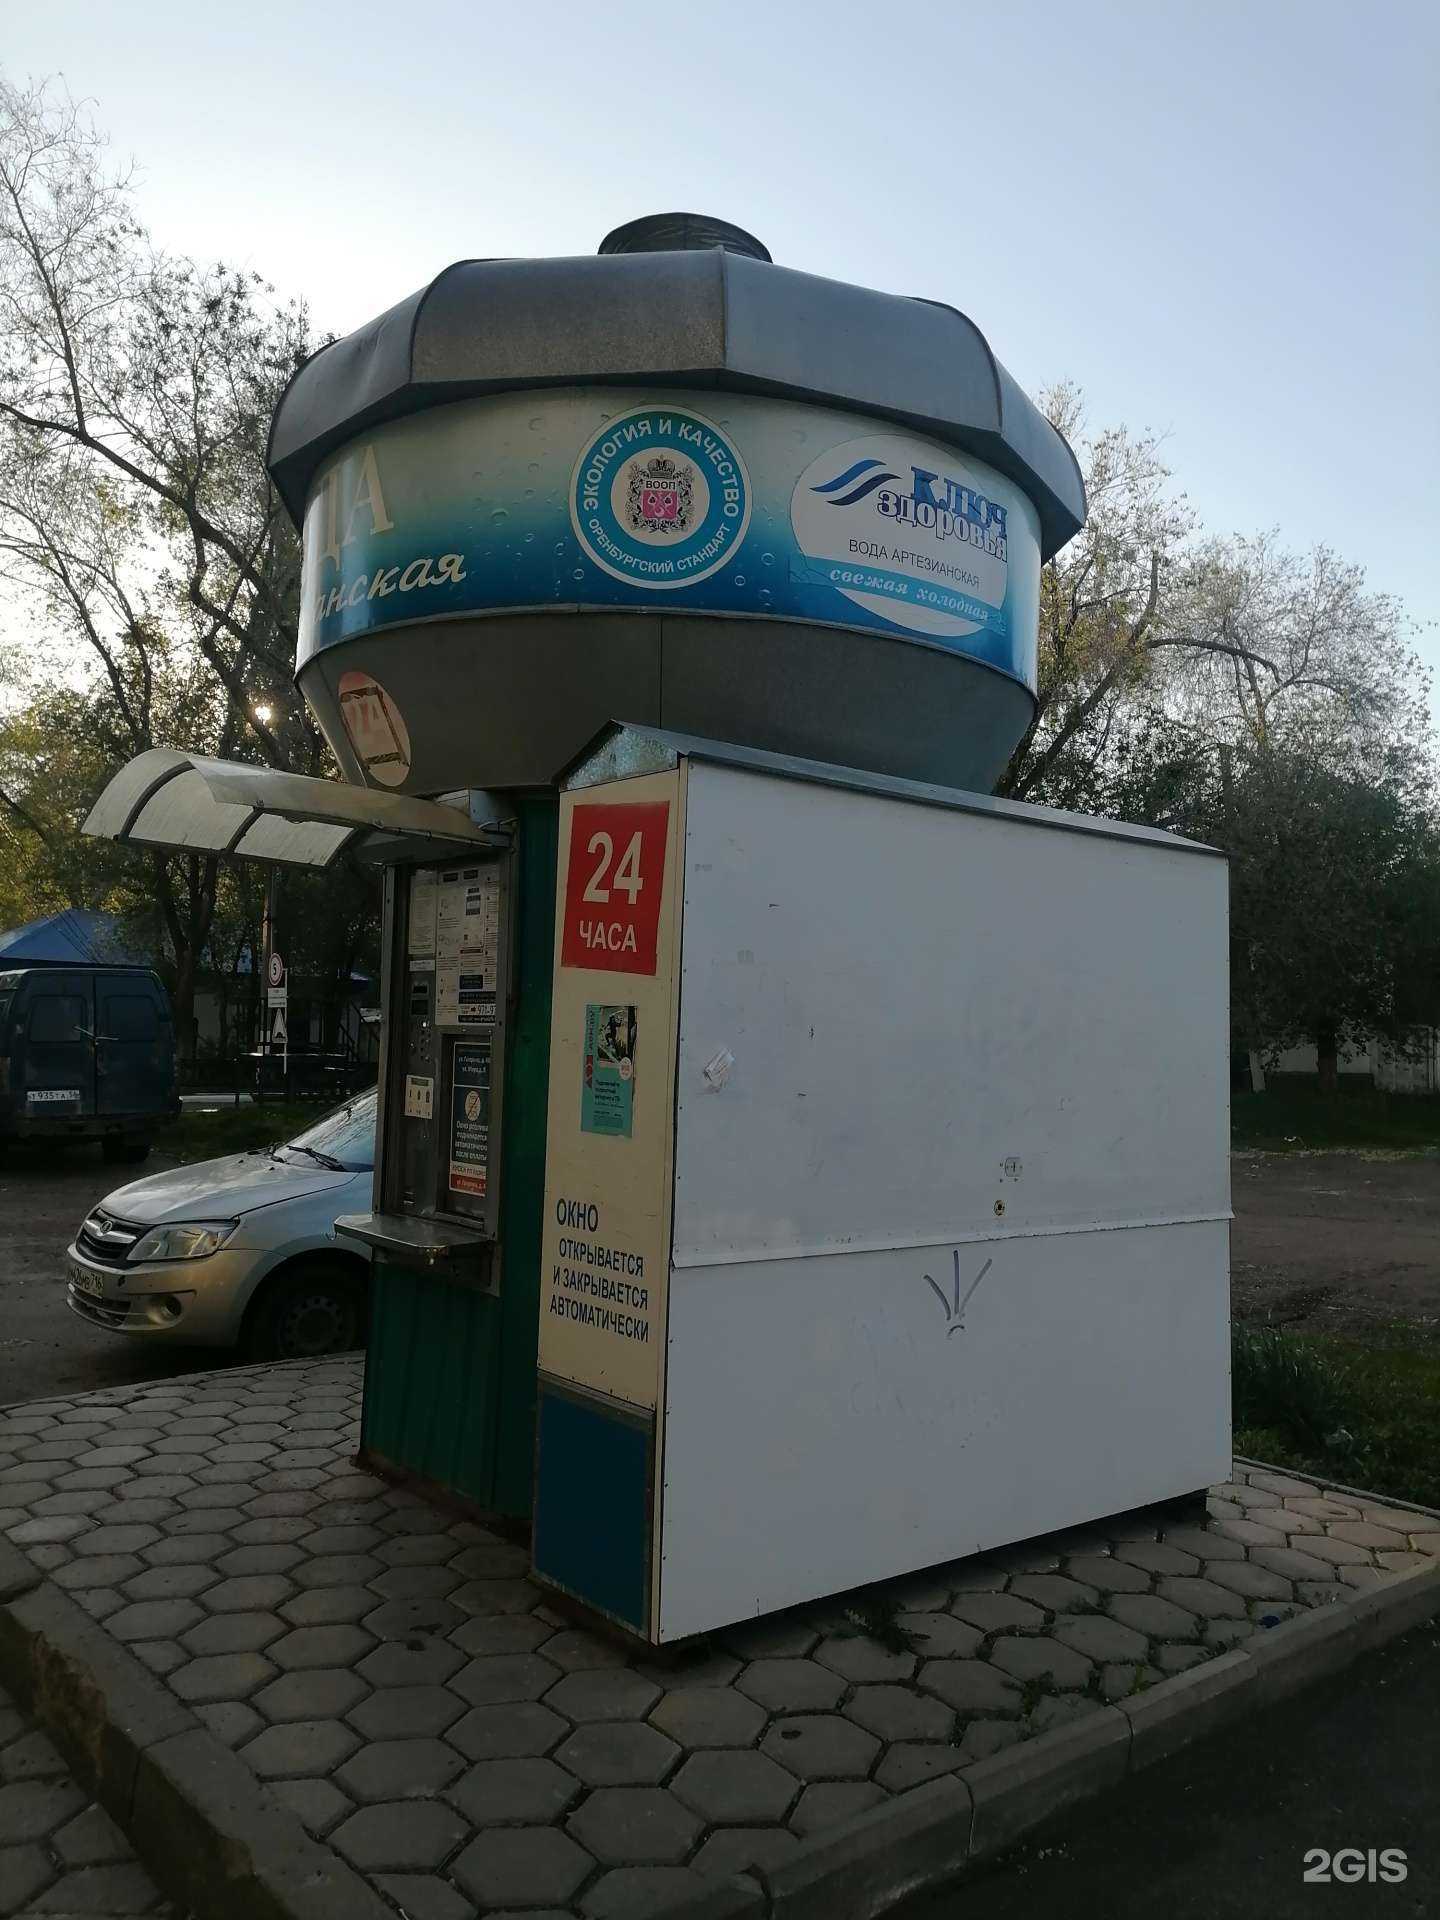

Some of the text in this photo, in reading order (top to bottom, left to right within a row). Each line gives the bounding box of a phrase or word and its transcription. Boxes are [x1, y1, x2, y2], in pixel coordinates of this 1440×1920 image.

[583, 418, 740, 518] ЭКОЛОГИЯ И КАЧЕСТВО
[645, 480, 677, 490] ВООП
[588, 518, 732, 574] ОРЕНБУРГСКИЙ СТАНДАРТ
[848, 539, 980, 590] ВОДА АРТЕЗИАНСКАЯ
[829, 567, 989, 621] свежая холодная
[583, 831, 643, 904] 24
[579, 920, 637, 952] ЧАСА
[556, 1198, 598, 1232] ОКНО
[559, 1238, 644, 1277] ОТКРЫВАЕТСЯ
[553, 1266, 648, 1310] И ЗАКРЫВАЕТСЯ
[549, 1295, 649, 1343] АВТОМАТИЧЕСКИ
